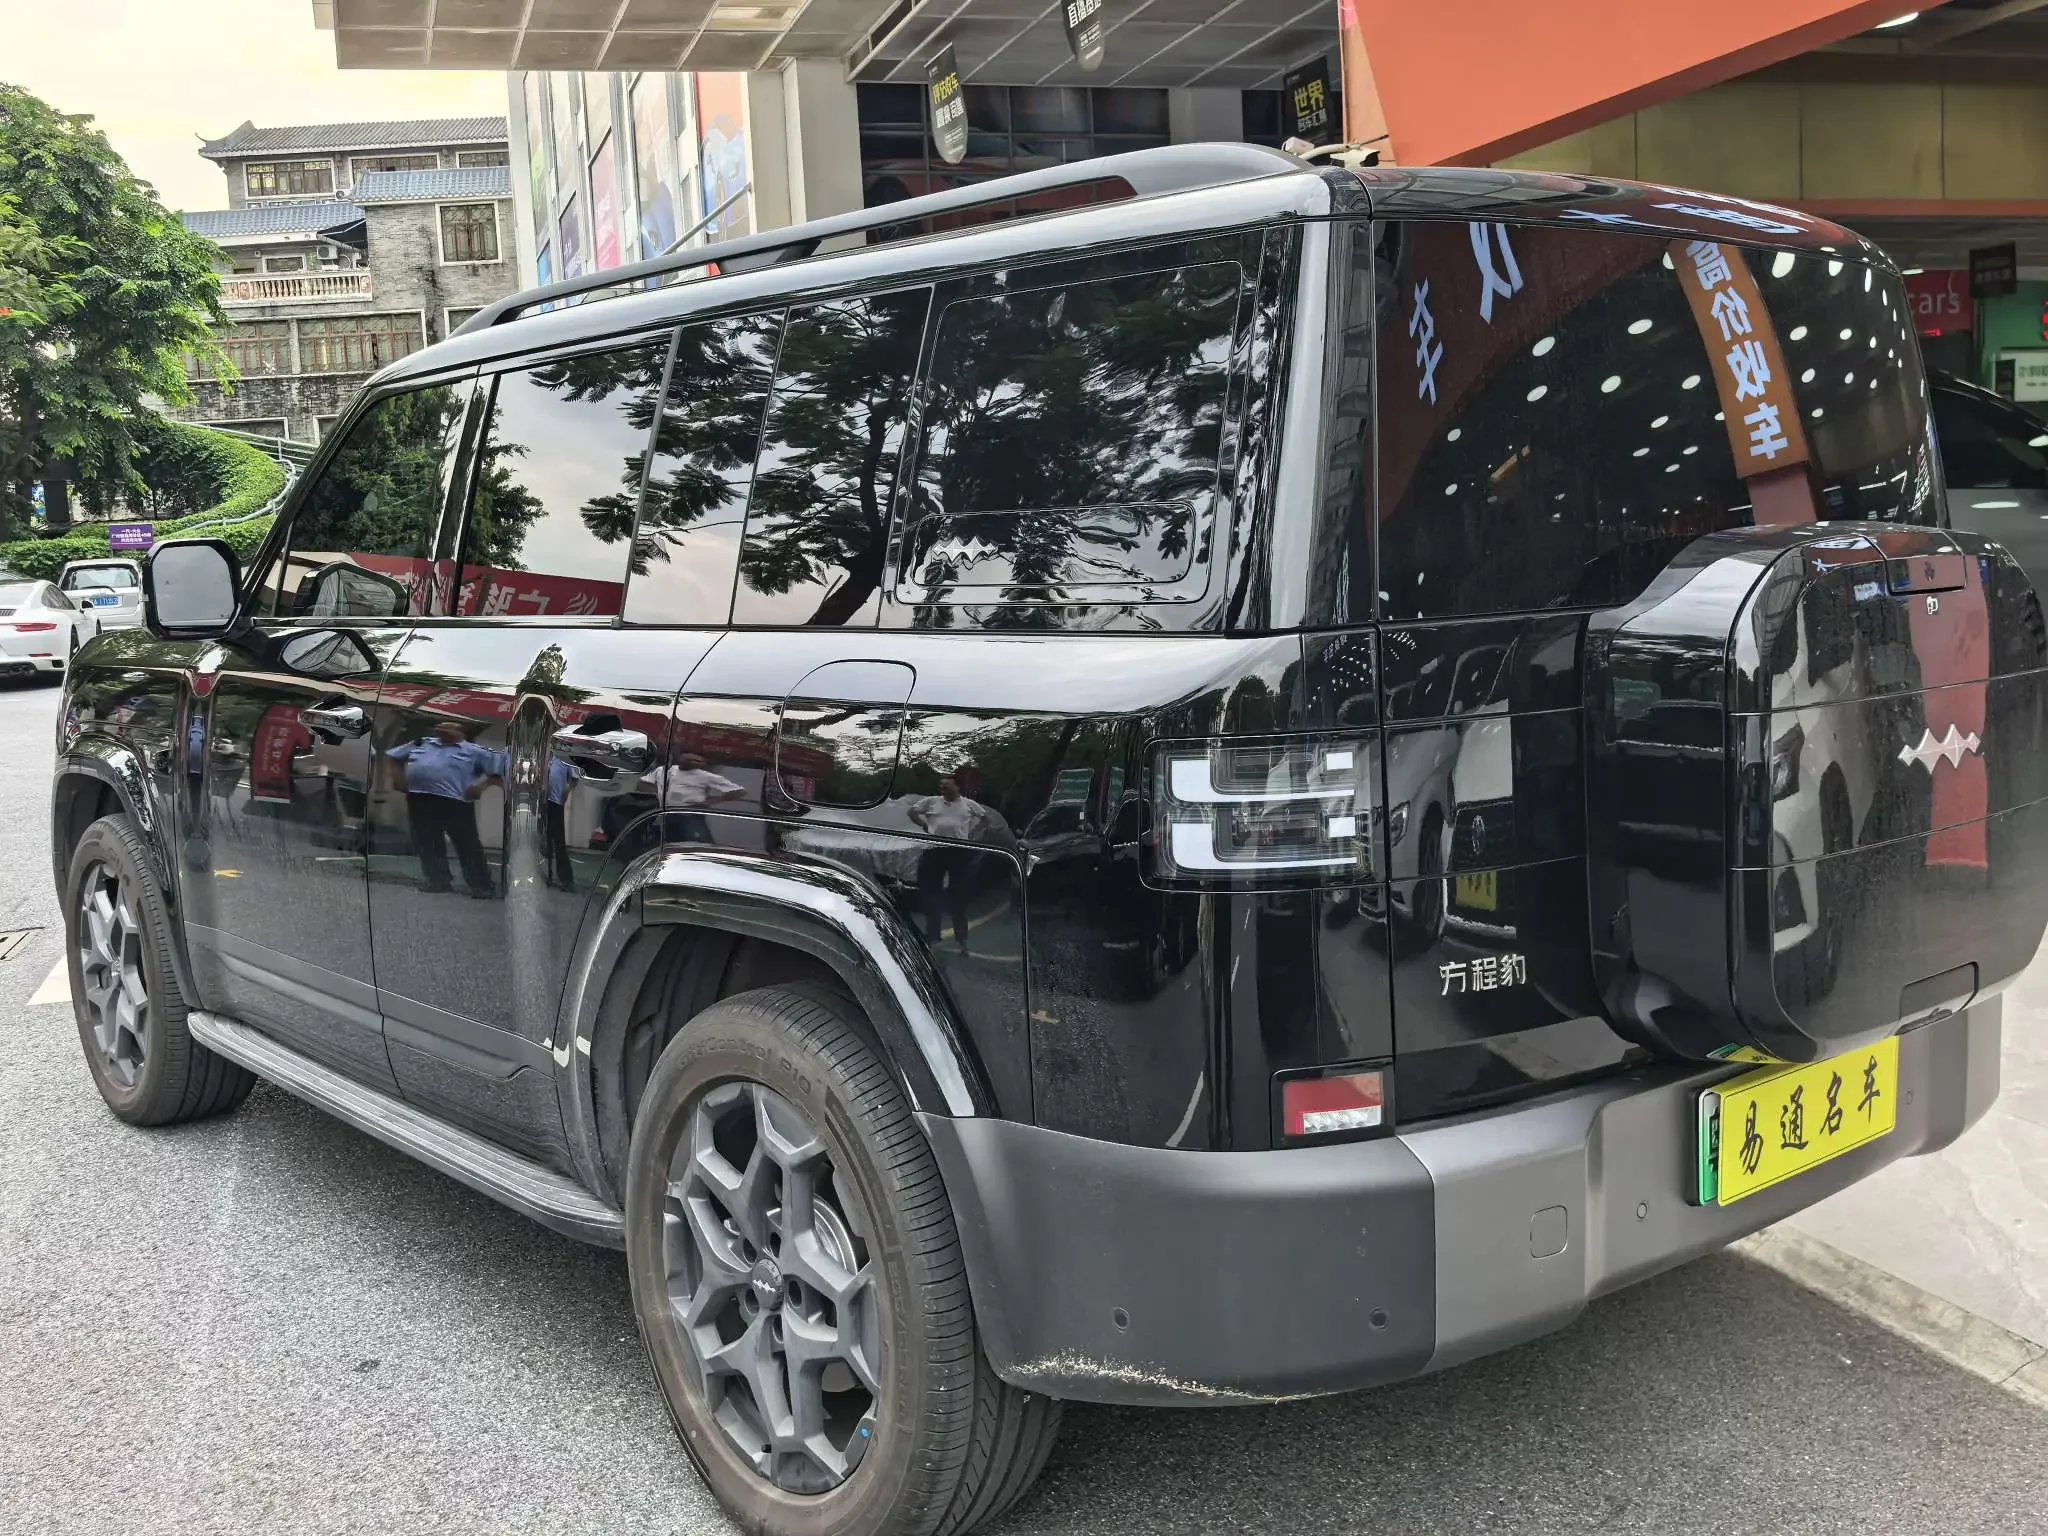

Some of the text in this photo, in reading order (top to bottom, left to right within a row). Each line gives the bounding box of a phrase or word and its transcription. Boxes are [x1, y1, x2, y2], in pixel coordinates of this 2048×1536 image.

[1294, 79, 1325, 118] 世界
[1438, 953, 1527, 996] 方程豹
[1739, 1055, 1881, 1176] 易通名车
